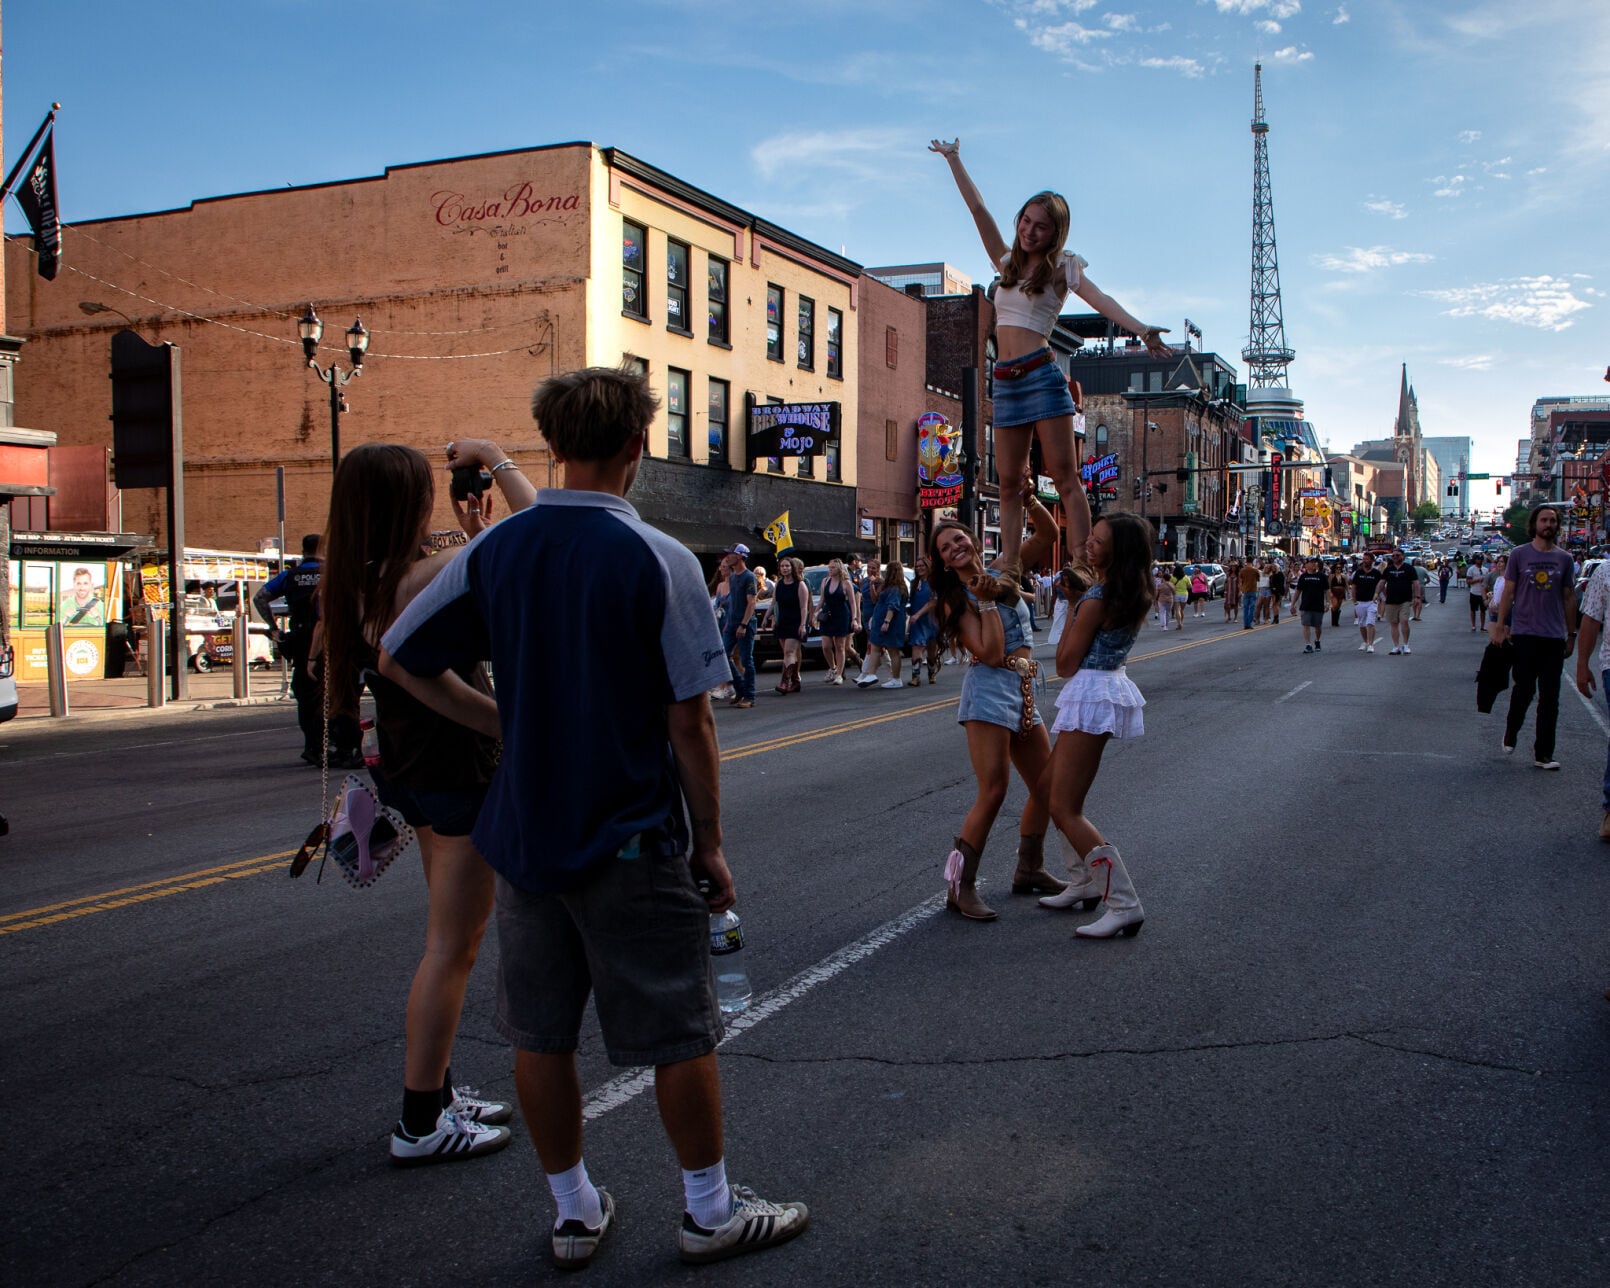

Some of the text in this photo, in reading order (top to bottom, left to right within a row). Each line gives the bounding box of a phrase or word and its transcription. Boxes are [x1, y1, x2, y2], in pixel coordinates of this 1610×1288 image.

[430, 180, 580, 226] Casa Bona
[751, 404, 831, 415] BROADWAY
[751, 412, 831, 435] BREWHOUSE
[784, 427, 795, 437] &
[780, 436, 814, 454] MOJO
[1099, 466, 1118, 482] ONK
[1272, 454, 1281, 520] FRIENDS
[921, 494, 960, 507] BOOTS
[24, 547, 80, 556] INFORMATION
